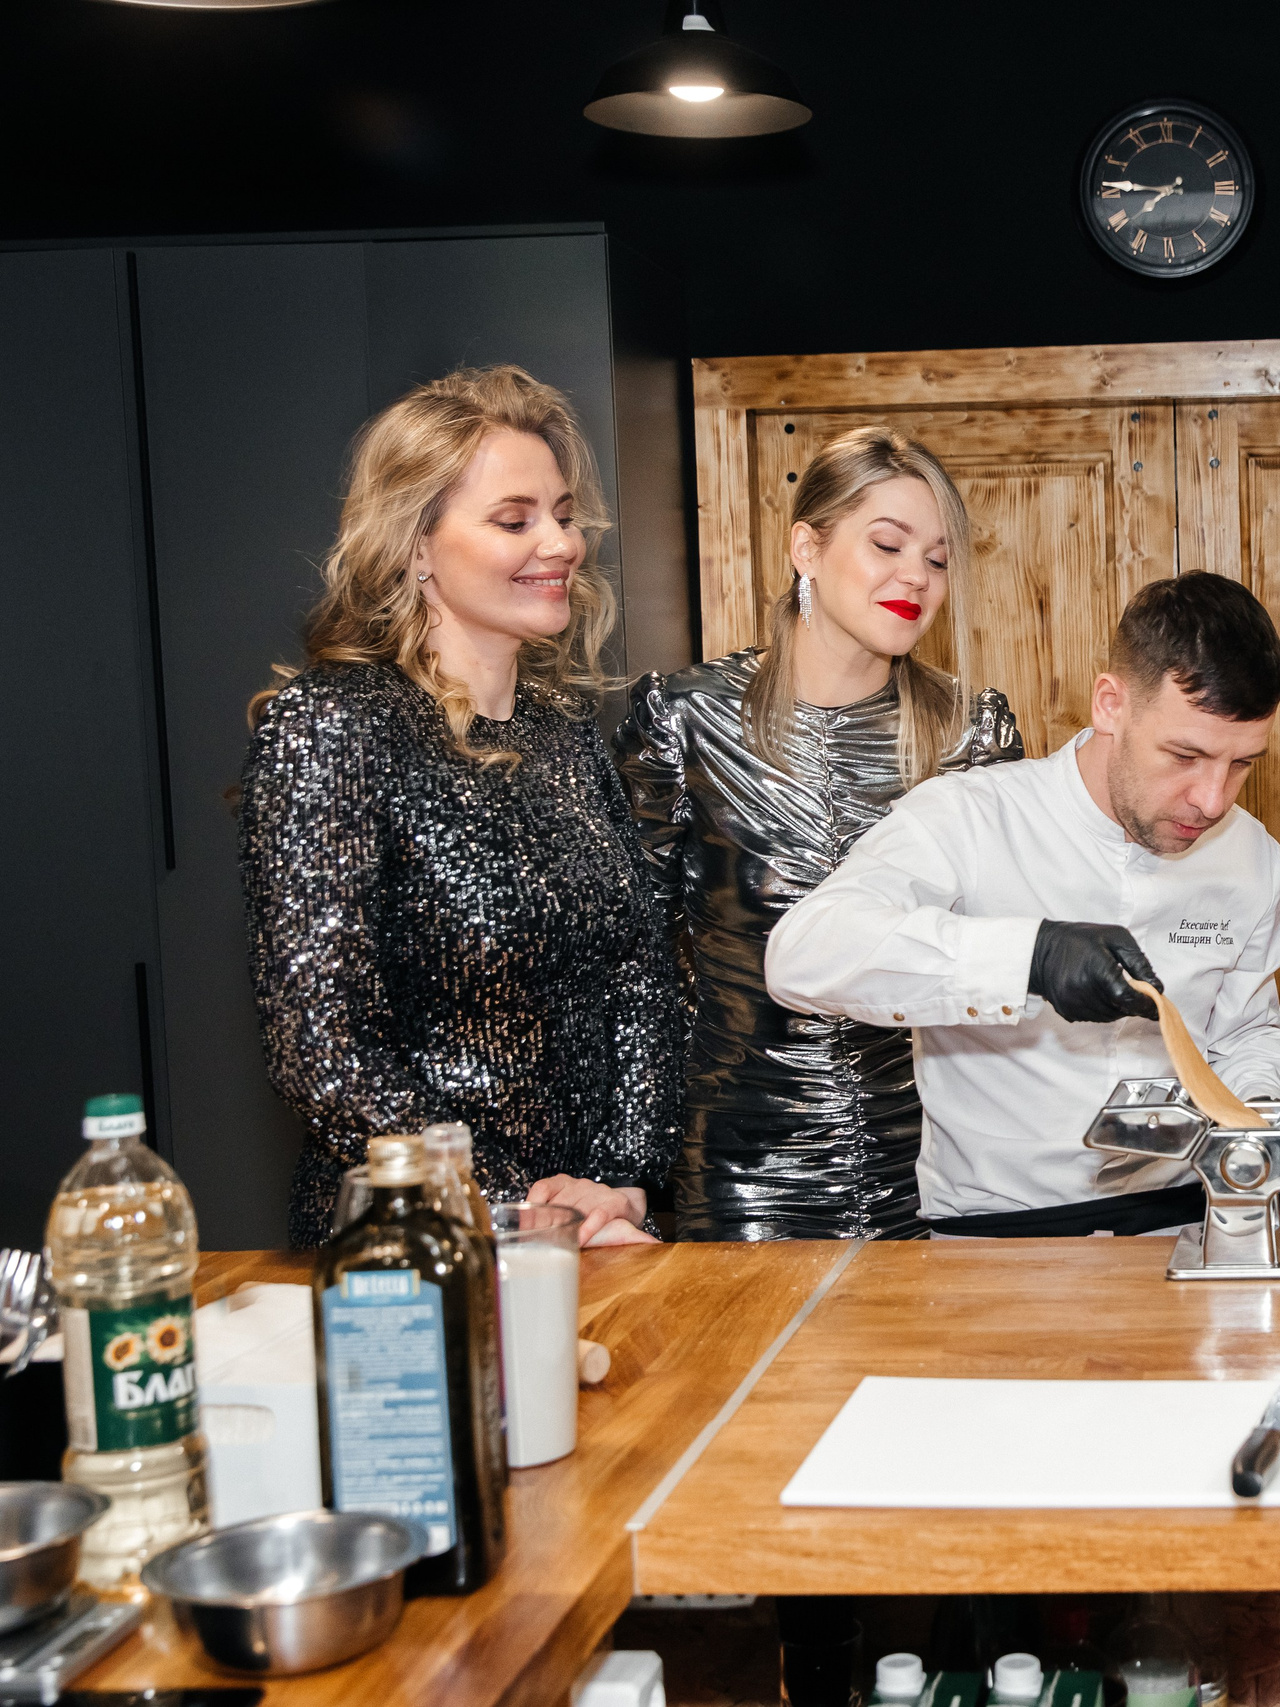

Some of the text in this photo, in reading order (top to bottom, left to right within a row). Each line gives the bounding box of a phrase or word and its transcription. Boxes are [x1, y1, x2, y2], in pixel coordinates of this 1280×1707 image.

[1206, 150, 1228, 168] II
[1214, 180, 1235, 196] III
[1163, 237, 1175, 258] VI
[1179, 918, 1219, 931] Executive
[1168, 932, 1211, 948] Мишарин
